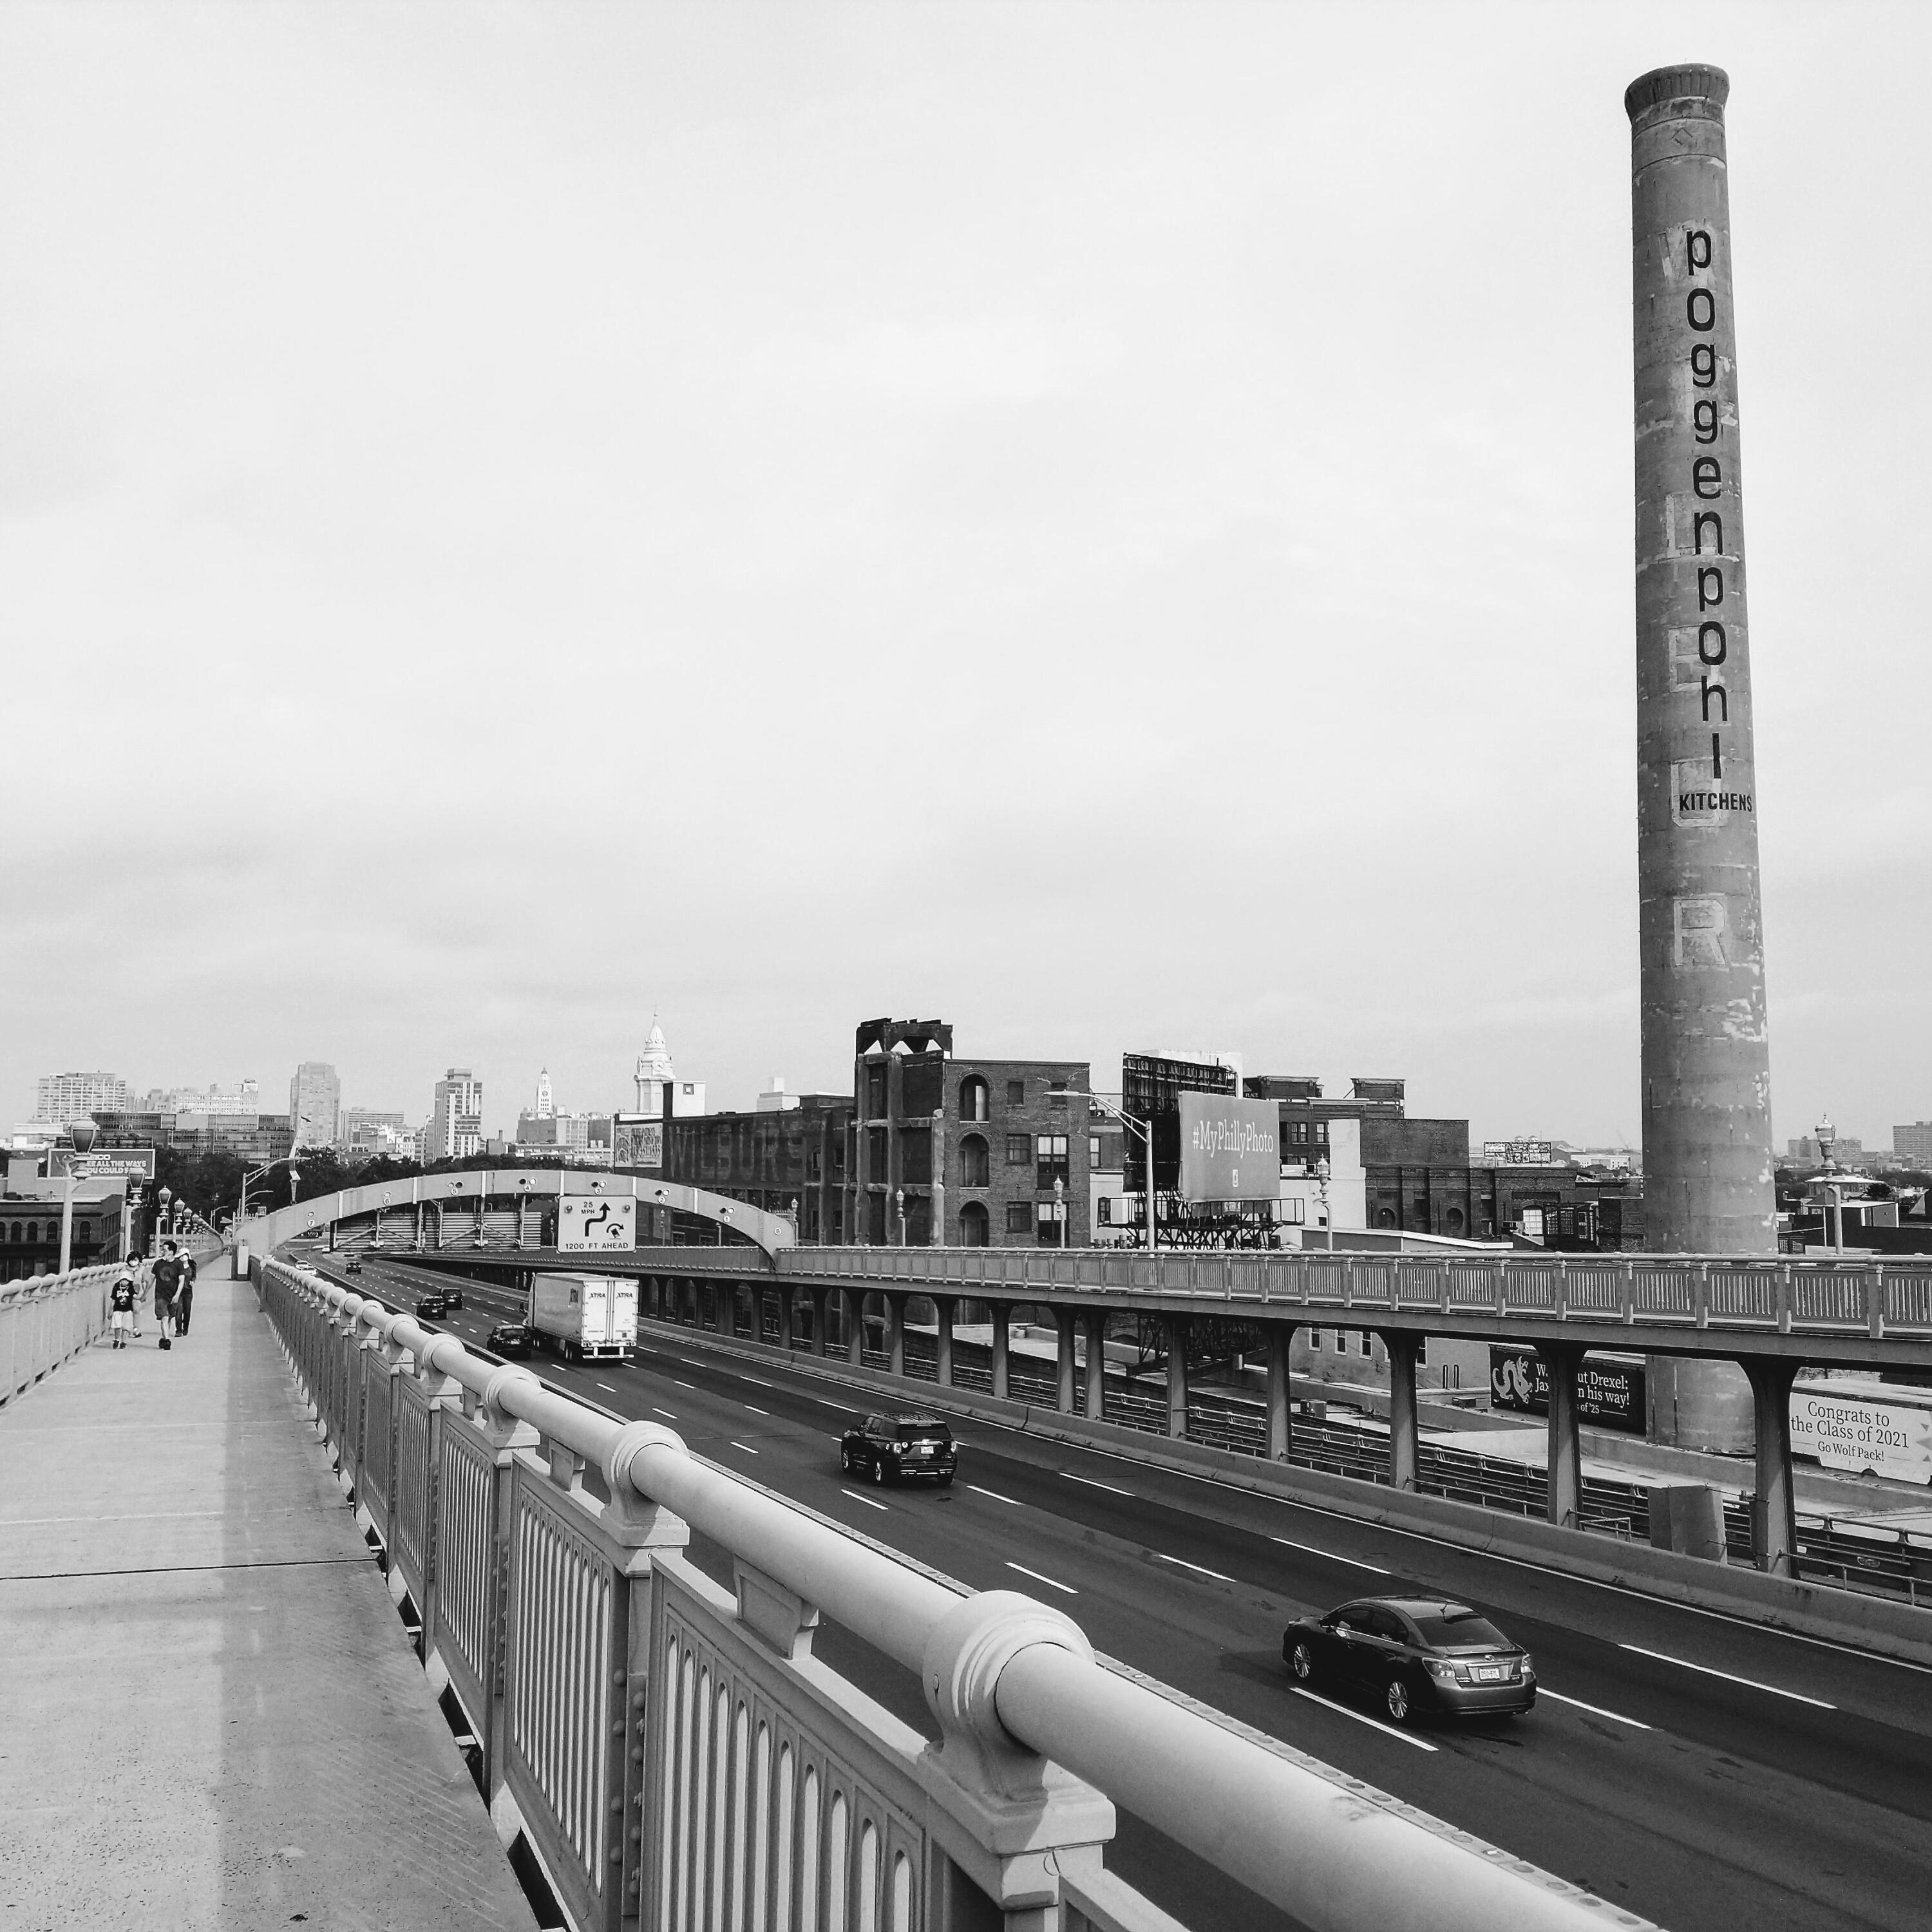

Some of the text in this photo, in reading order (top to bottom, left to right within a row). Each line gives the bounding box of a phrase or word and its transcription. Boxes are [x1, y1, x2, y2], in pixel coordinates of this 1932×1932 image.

[1686, 230, 1728, 779] poggenpohl
[1679, 792, 1752, 812] KITCHENS
[1193, 1119, 1274, 1159] #MyPhillyPhoto
[1577, 1371, 1629, 1390] ut Drexel:
[1577, 1385, 1630, 1408] n his way!
[1580, 1402, 1589, 1413] of
[1808, 1401, 1889, 1427] Congrats to
[1790, 1416, 1909, 1448] the Class of 2021
[1817, 1441, 1885, 1462] Go Wolf Pack!
